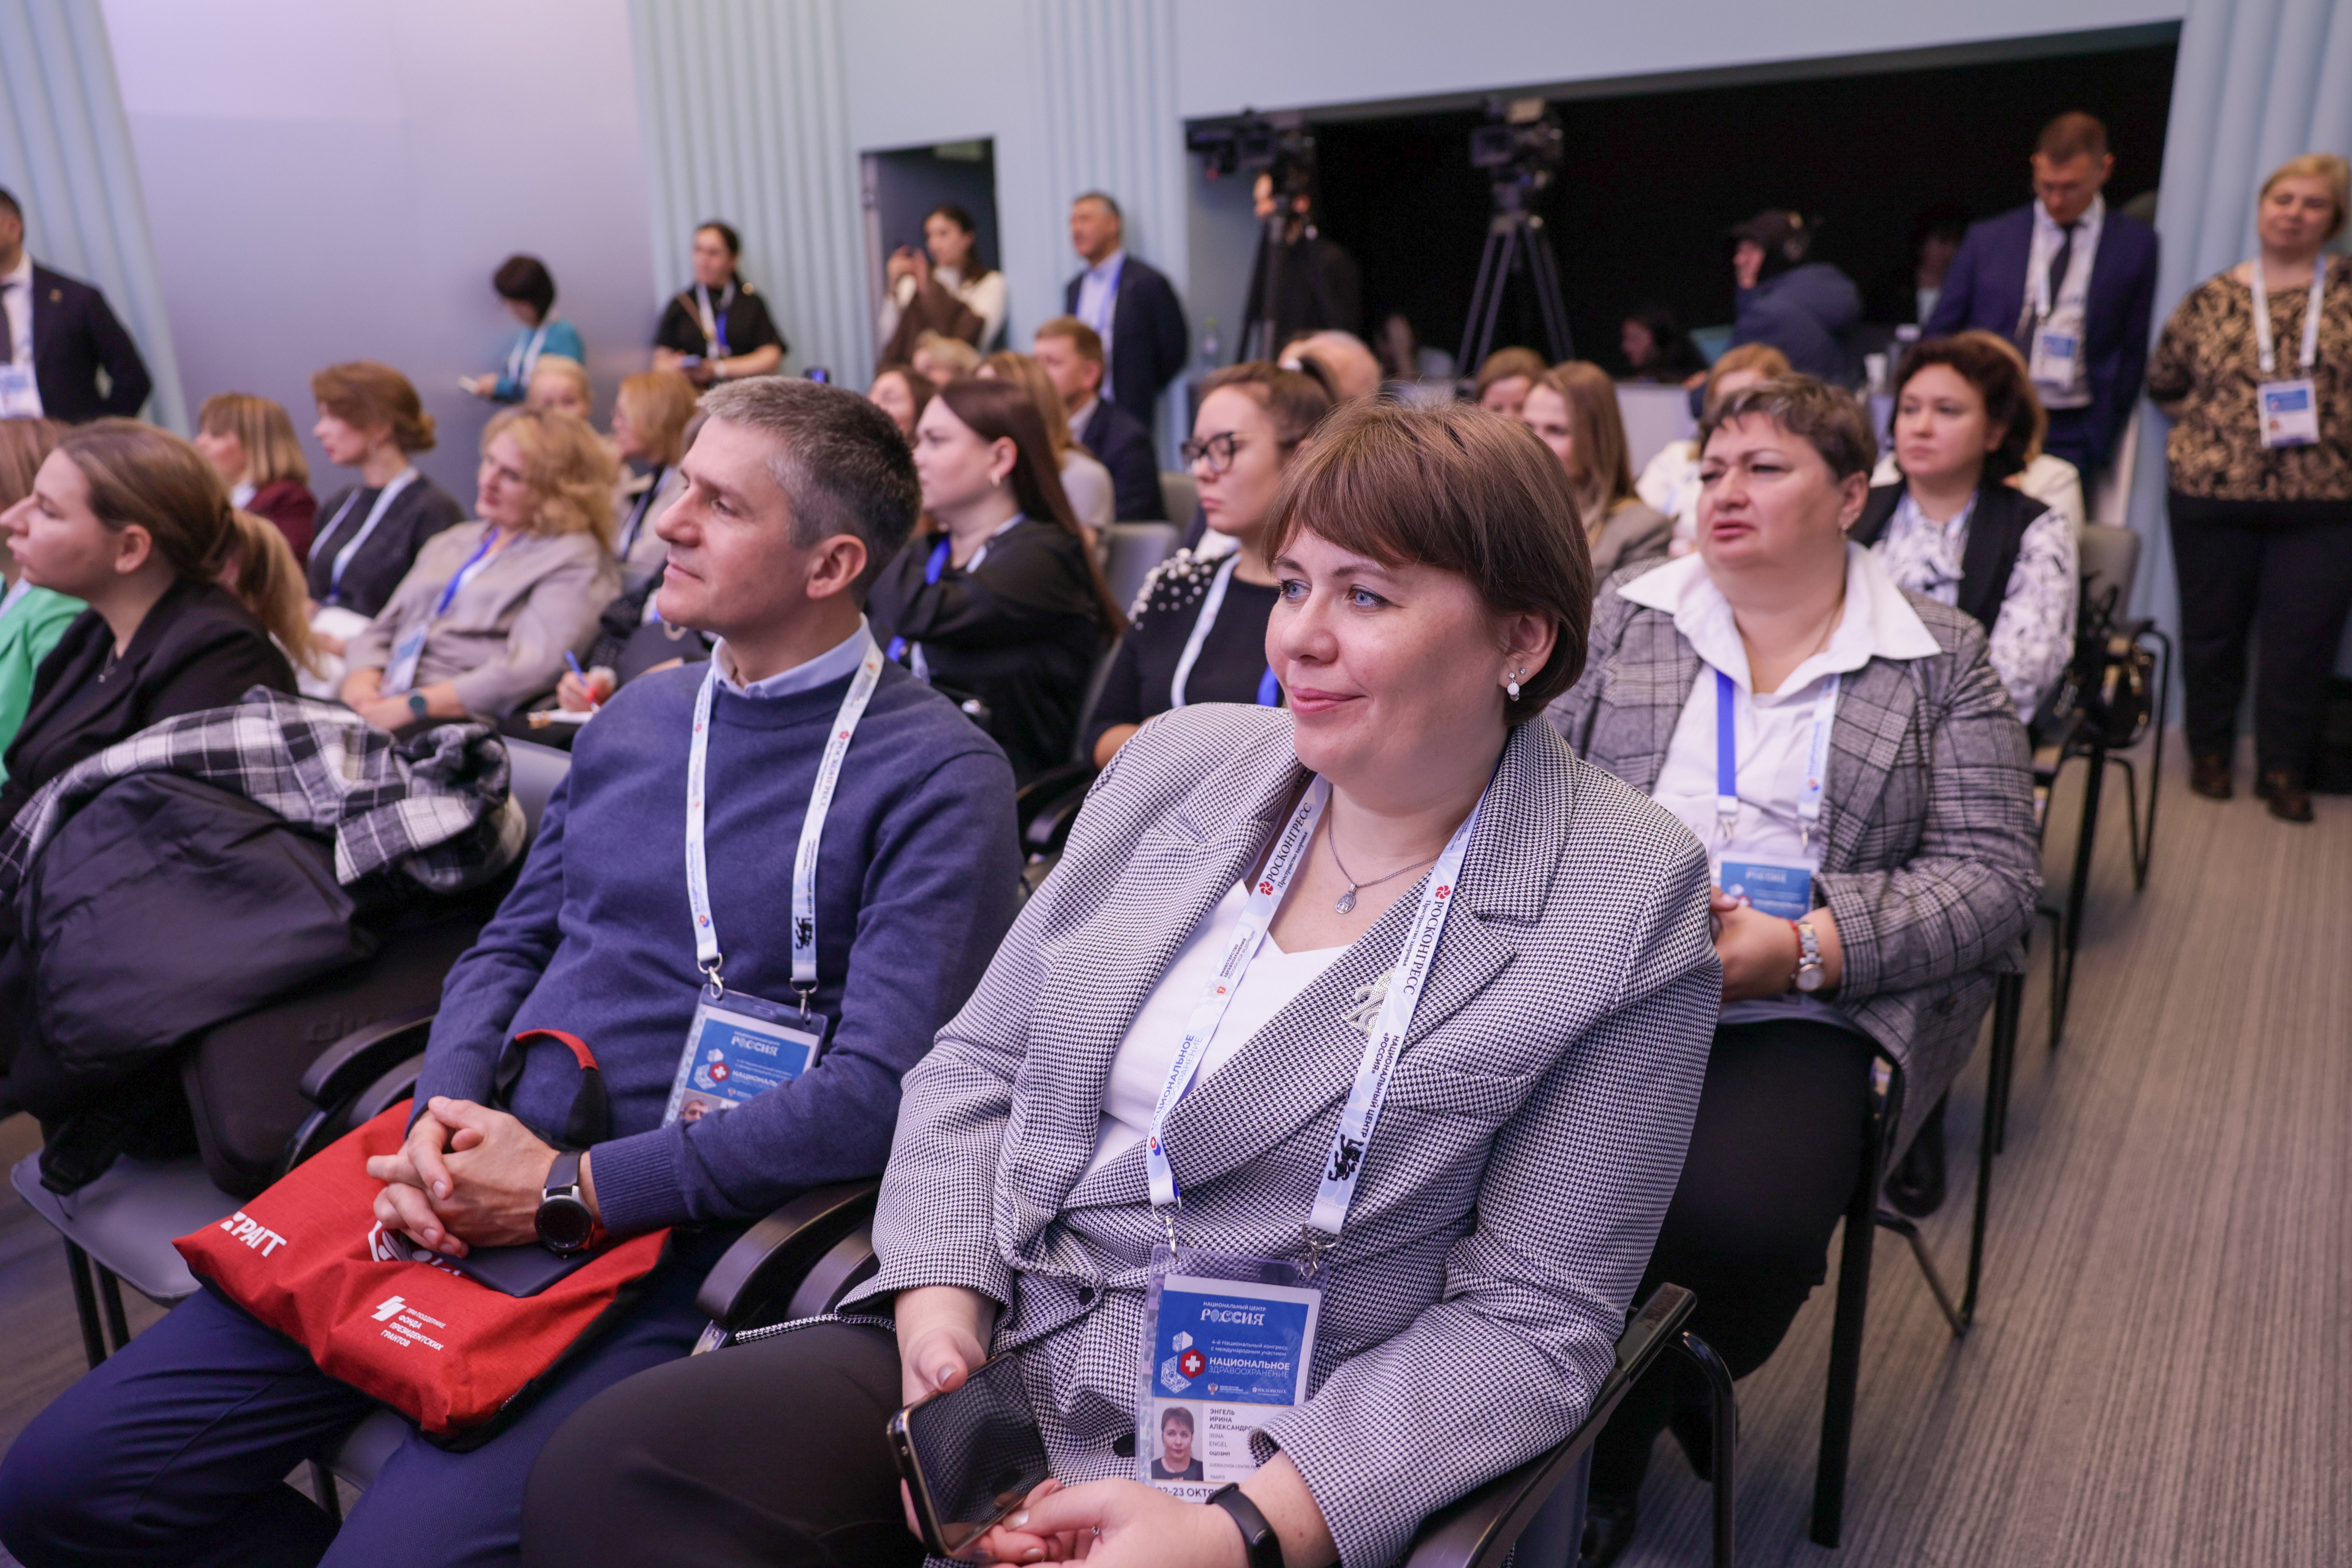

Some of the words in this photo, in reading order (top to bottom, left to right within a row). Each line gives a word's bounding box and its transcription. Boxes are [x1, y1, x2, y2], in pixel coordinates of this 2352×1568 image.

[1266, 802, 1312, 882] РОСКОНГРЕСС
[1277, 853, 1298, 888] Пространство
[1295, 831, 1308, 854] здоровья
[1412, 900, 1431, 939] Пространство
[1219, 944, 1238, 977] МИНИСТЕРСТВО
[1224, 938, 1246, 977] ЗДРАВООХРАНЕНИЯ
[1228, 953, 1243, 979] РОССИЙСКОЙ
[1241, 930, 1256, 953] ФЕДЕРАЦИИ
[1402, 940, 1415, 967] здоровья
[1403, 900, 1444, 995] РОСКОНГРЕСС
[1371, 1032, 1390, 1075] «РОССИЯ»
[1369, 1035, 1400, 1109] НАЦИОНАЛЬНЫЙ
[1359, 1108, 1375, 1138] ЦЕНТР
[1200, 1308, 1265, 1326] РОССИЯ
[1203, 1301, 1249, 1309] НАЦИОНАЛЬНЫЙ
[389, 1322, 444, 1351] ПРЕЗИДЕНТСКИХ
[398, 1315, 422, 1329] ФОНДА
[380, 1329, 410, 1347] ГРАНТОВ
[1209, 1366, 1289, 1378] ЗДРАВООХРАНЕНИЕ
[1210, 1357, 1290, 1370] НАЦИОНАЛЬНОЕ
[1187, 1488, 1217, 1498] ОКТЯ
